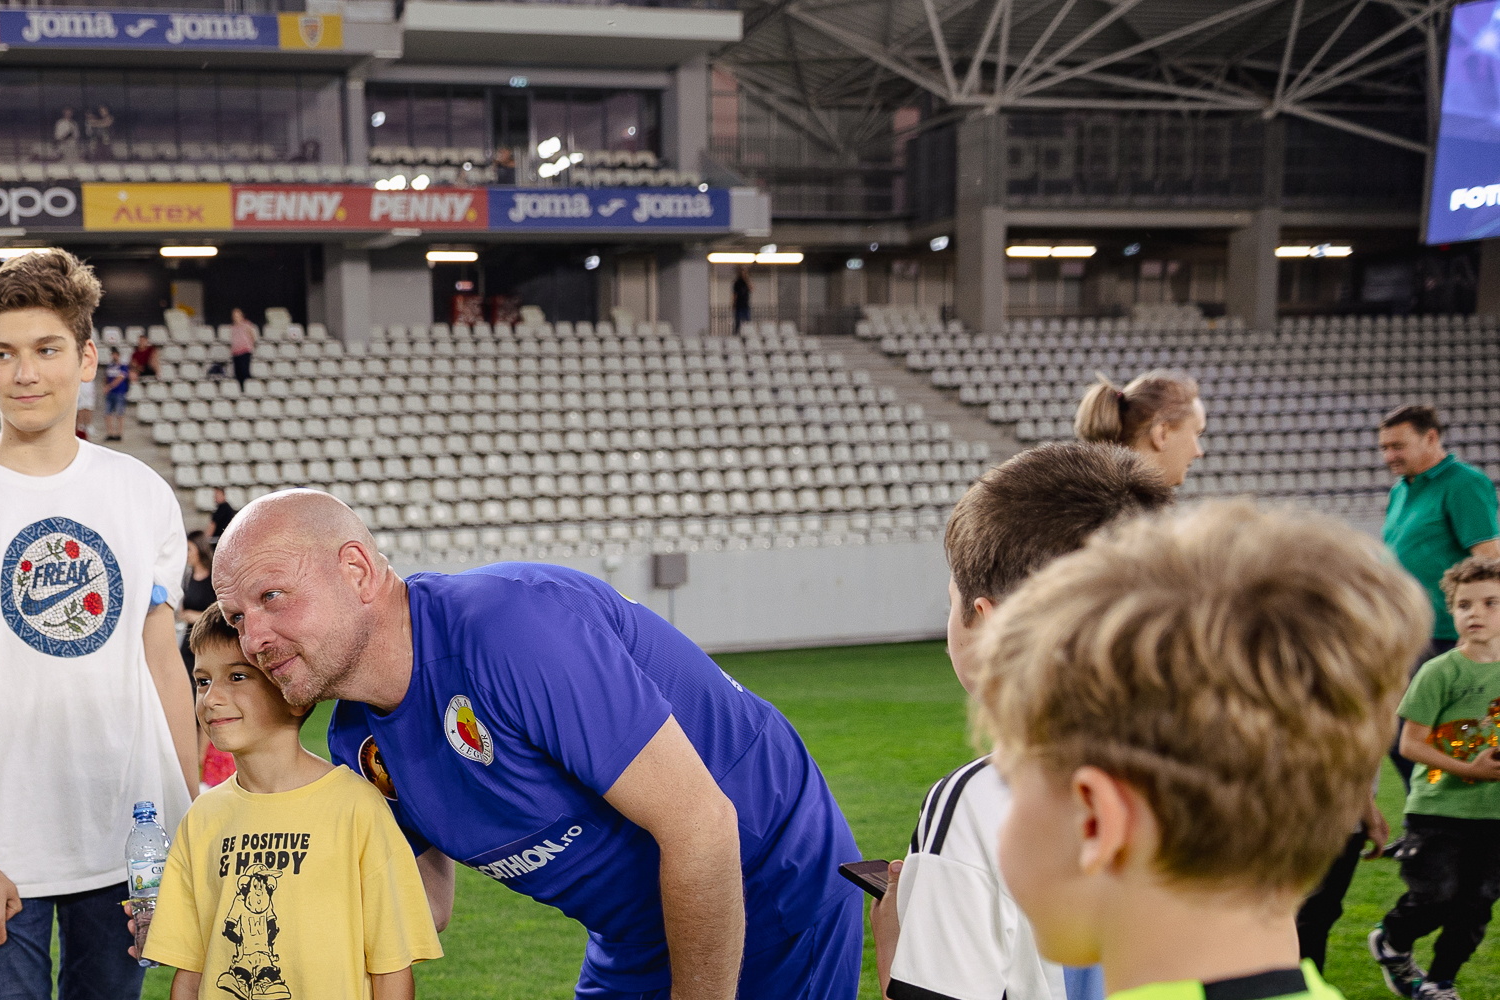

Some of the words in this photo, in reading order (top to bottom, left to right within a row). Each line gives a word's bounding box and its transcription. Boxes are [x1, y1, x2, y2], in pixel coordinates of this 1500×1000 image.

[1449, 184, 1500, 211] FOT
[32, 559, 93, 588] FREAK
[221, 836, 237, 853] BE
[241, 833, 311, 851] POSITIVE
[219, 855, 230, 877] &
